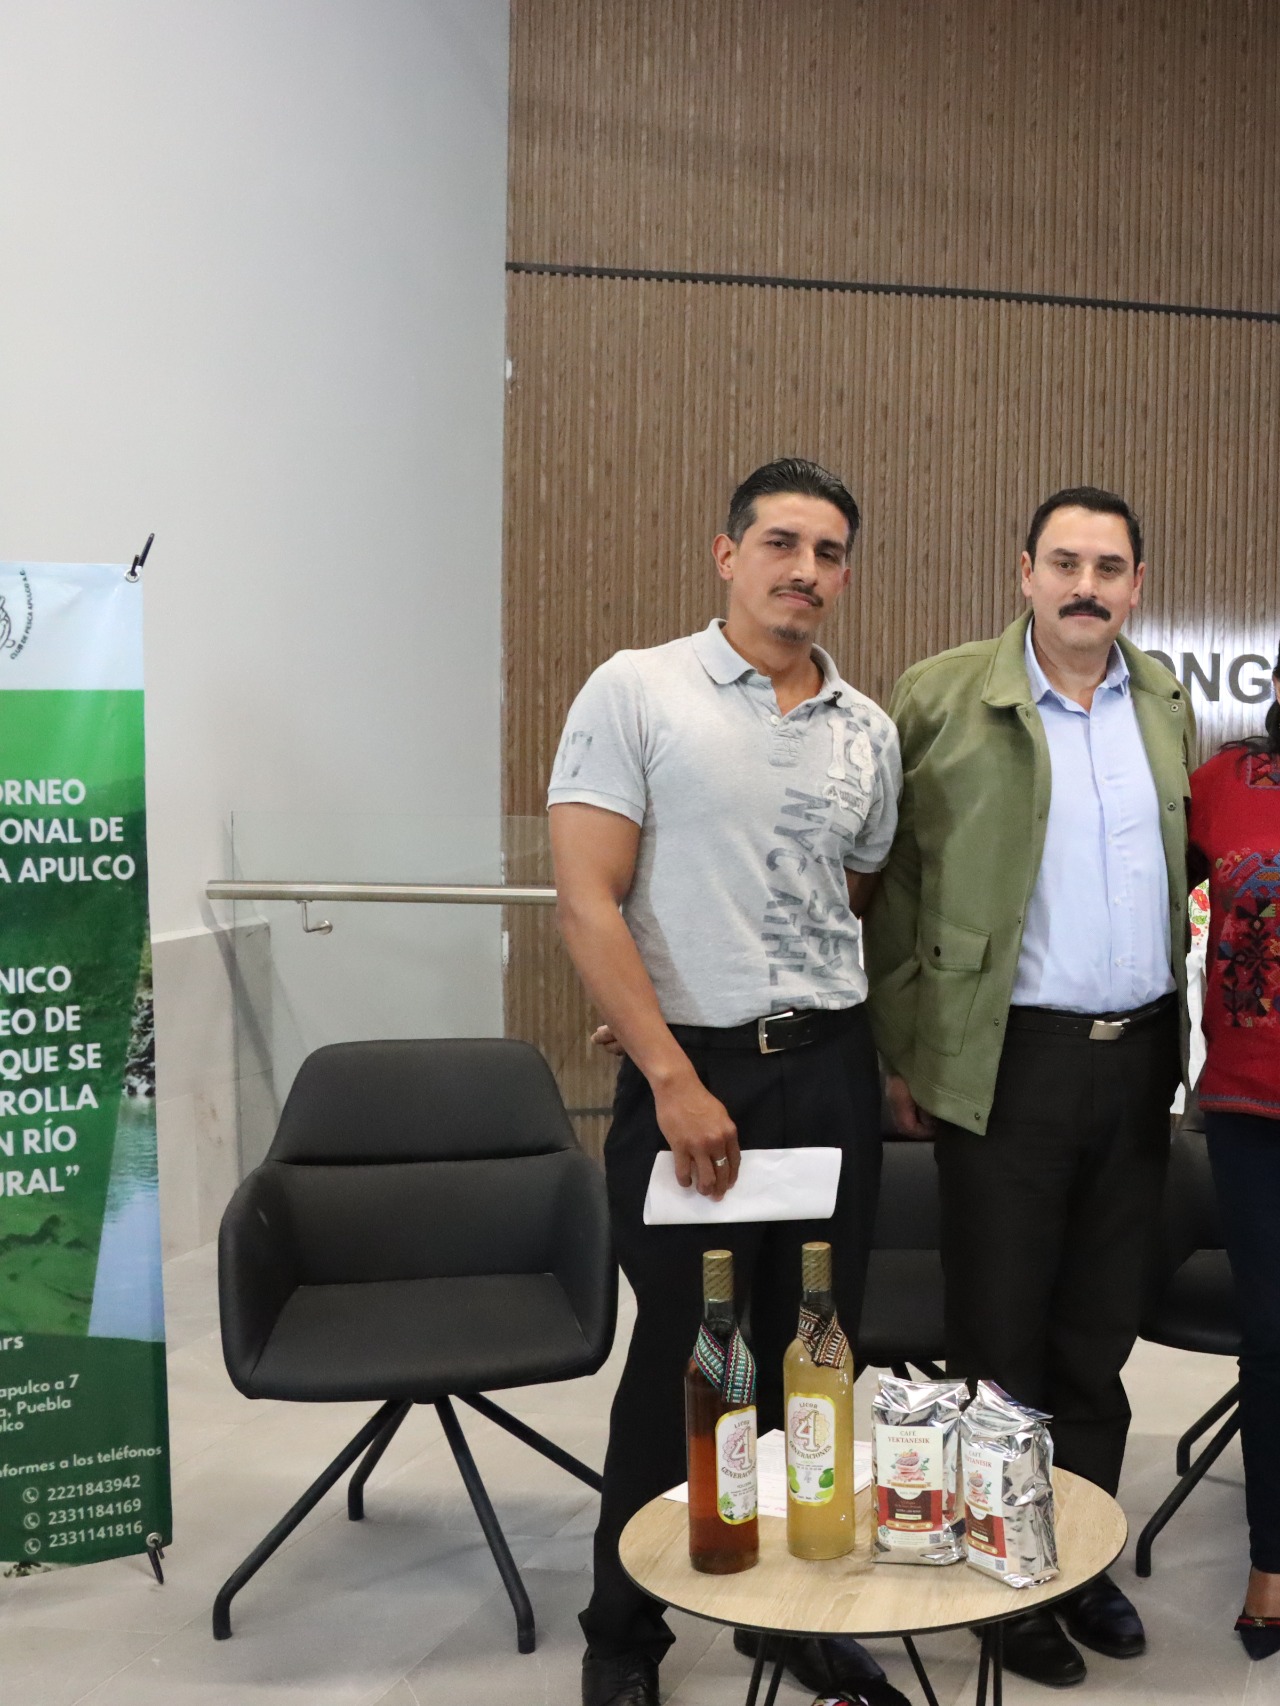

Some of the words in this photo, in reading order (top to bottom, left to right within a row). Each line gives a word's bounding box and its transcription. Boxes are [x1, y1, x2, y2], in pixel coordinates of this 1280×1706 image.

[24, 582, 33, 610] APULCO
[25, 611, 33, 634] PESCA
[0, 778, 86, 806] RNEO
[90, 816, 124, 842] DE
[765, 787, 834, 877] NYC
[18, 854, 136, 883] APULCO
[45, 1005, 81, 1033] DE
[0, 1045, 60, 1081] QUE
[67, 1043, 102, 1071] SE
[23, 1118, 77, 1155] RÍO
[0, 1336, 24, 1350] rs
[54, 1381, 65, 1390] a
[69, 1374, 80, 1388] 7
[16, 1395, 72, 1415] Puebla
[0, 1419, 24, 1433] lco
[0, 1460, 56, 1479] formes
[59, 1459, 69, 1469] a
[73, 1454, 94, 1467] los
[97, 1445, 163, 1464] teléfonos
[789, 1440, 832, 1460] GENERACIONES
[47, 1474, 141, 1501] 2221843942
[48, 1498, 142, 1525] 2331184169
[49, 1520, 143, 1548] 2331141816
